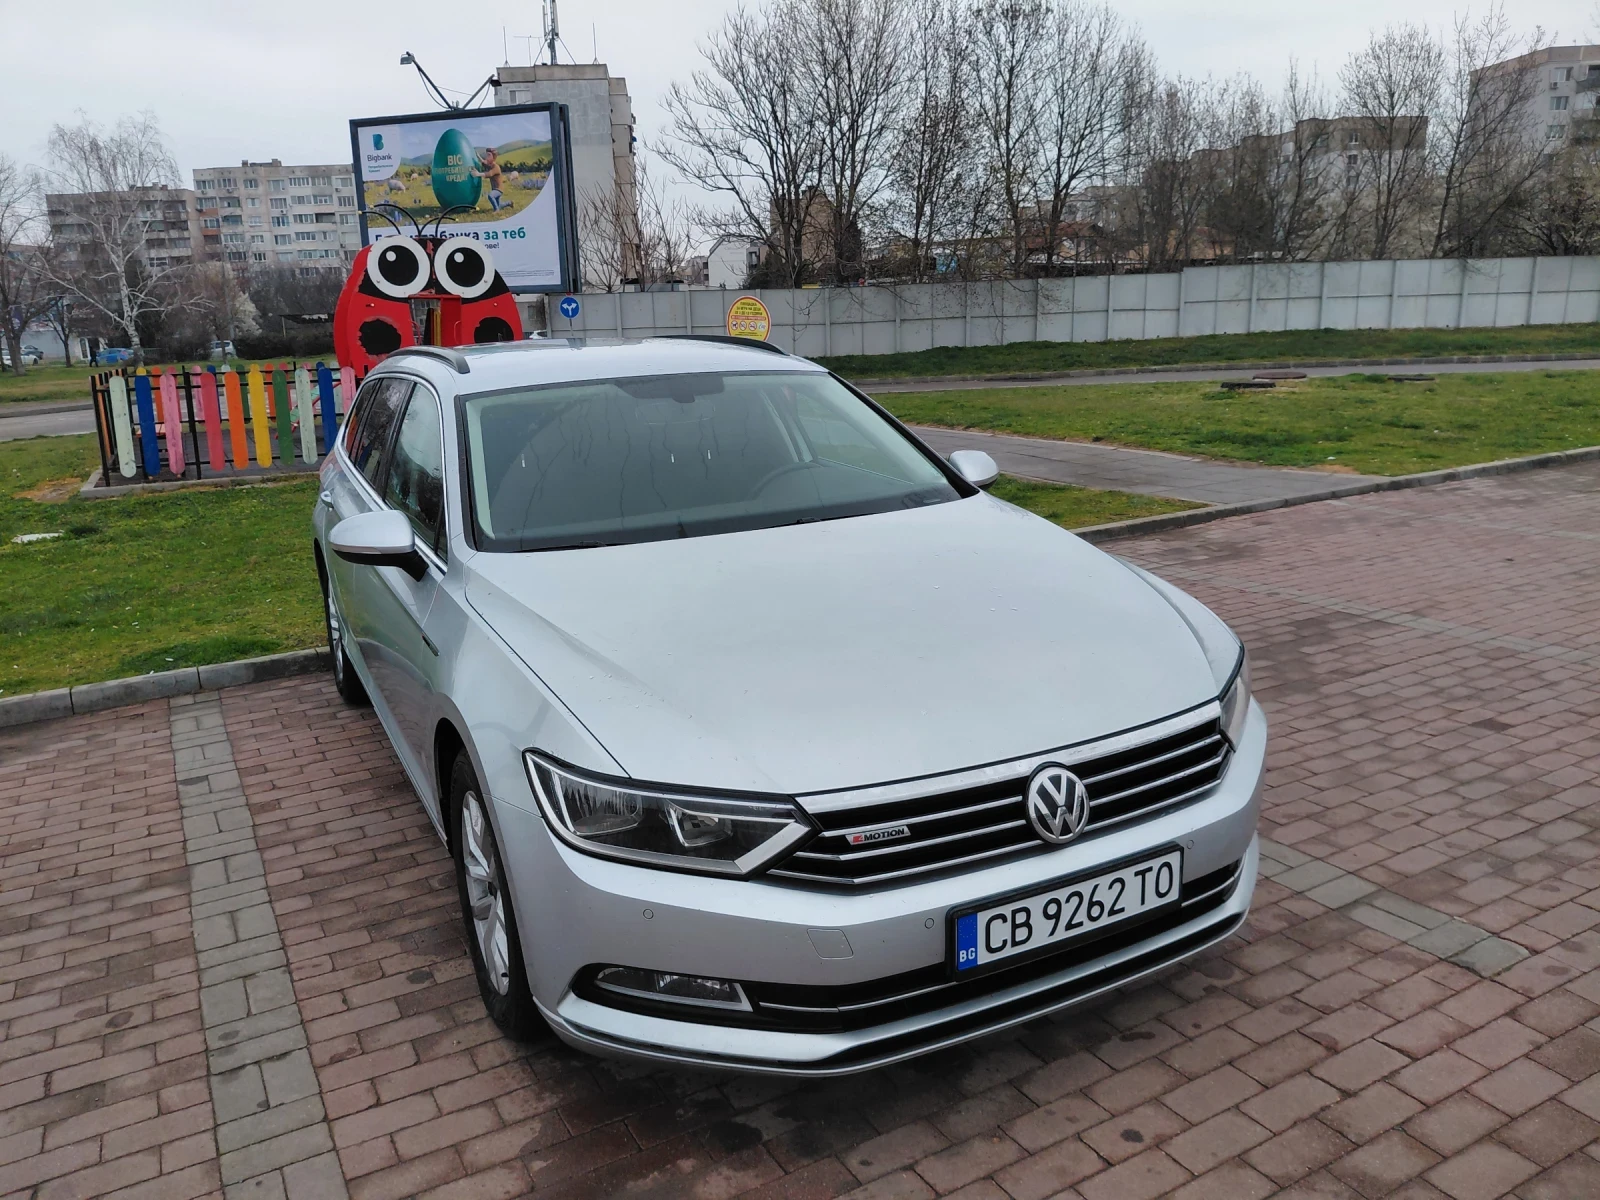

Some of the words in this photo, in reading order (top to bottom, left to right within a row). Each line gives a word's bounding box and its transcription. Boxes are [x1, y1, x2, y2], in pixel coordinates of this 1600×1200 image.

[367, 153, 393, 163] Bigbank
[447, 154, 463, 166] BIG
[484, 231, 498, 240] за
[502, 227, 526, 239] теб
[1043, 877, 1126, 937] 9262
[959, 947, 976, 962] BG
